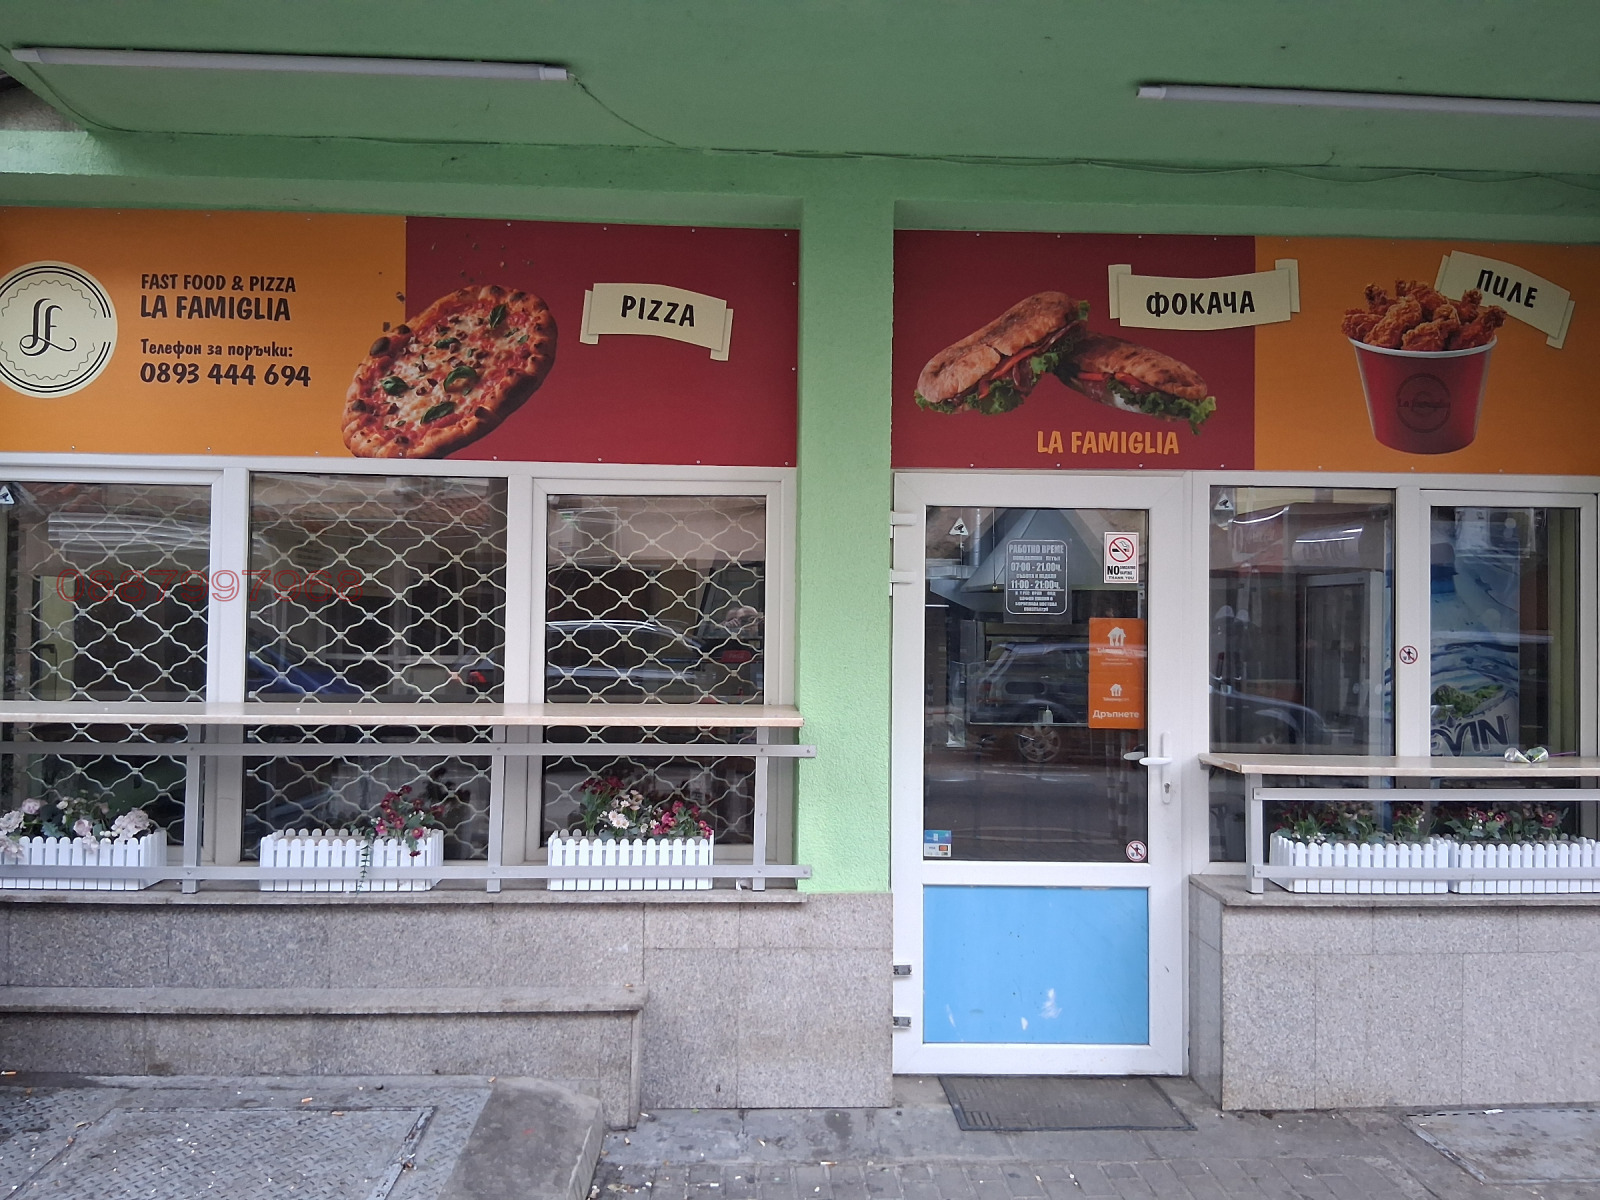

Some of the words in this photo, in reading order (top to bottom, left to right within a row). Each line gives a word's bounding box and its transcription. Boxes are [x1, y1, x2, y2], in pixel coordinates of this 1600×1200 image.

[141, 273, 179, 290] FAST
[183, 274, 227, 291] FOOD
[232, 275, 244, 292] &
[249, 275, 297, 294] PIZZA
[1476, 268, 1538, 309] ПИЛЕ
[140, 294, 168, 319] LA
[176, 295, 291, 322] FAMIGLIA
[620, 294, 695, 328] PIZZA
[1146, 290, 1256, 318] ФОКАЧА
[140, 338, 202, 360] Телефон
[206, 344, 223, 356] за
[227, 340, 293, 361] поръчки:
[140, 362, 200, 384] 0893
[207, 363, 257, 386] 444
[263, 363, 312, 388] 694
[1037, 430, 1063, 455] LA
[1071, 431, 1180, 455] FAMIGLIA
[1009, 544, 1041, 554] РАБОТНО
[1041, 544, 1064, 554] ВРЕМЕ
[1107, 565, 1120, 575] NO
[1092, 709, 1140, 719] Дръпнете
